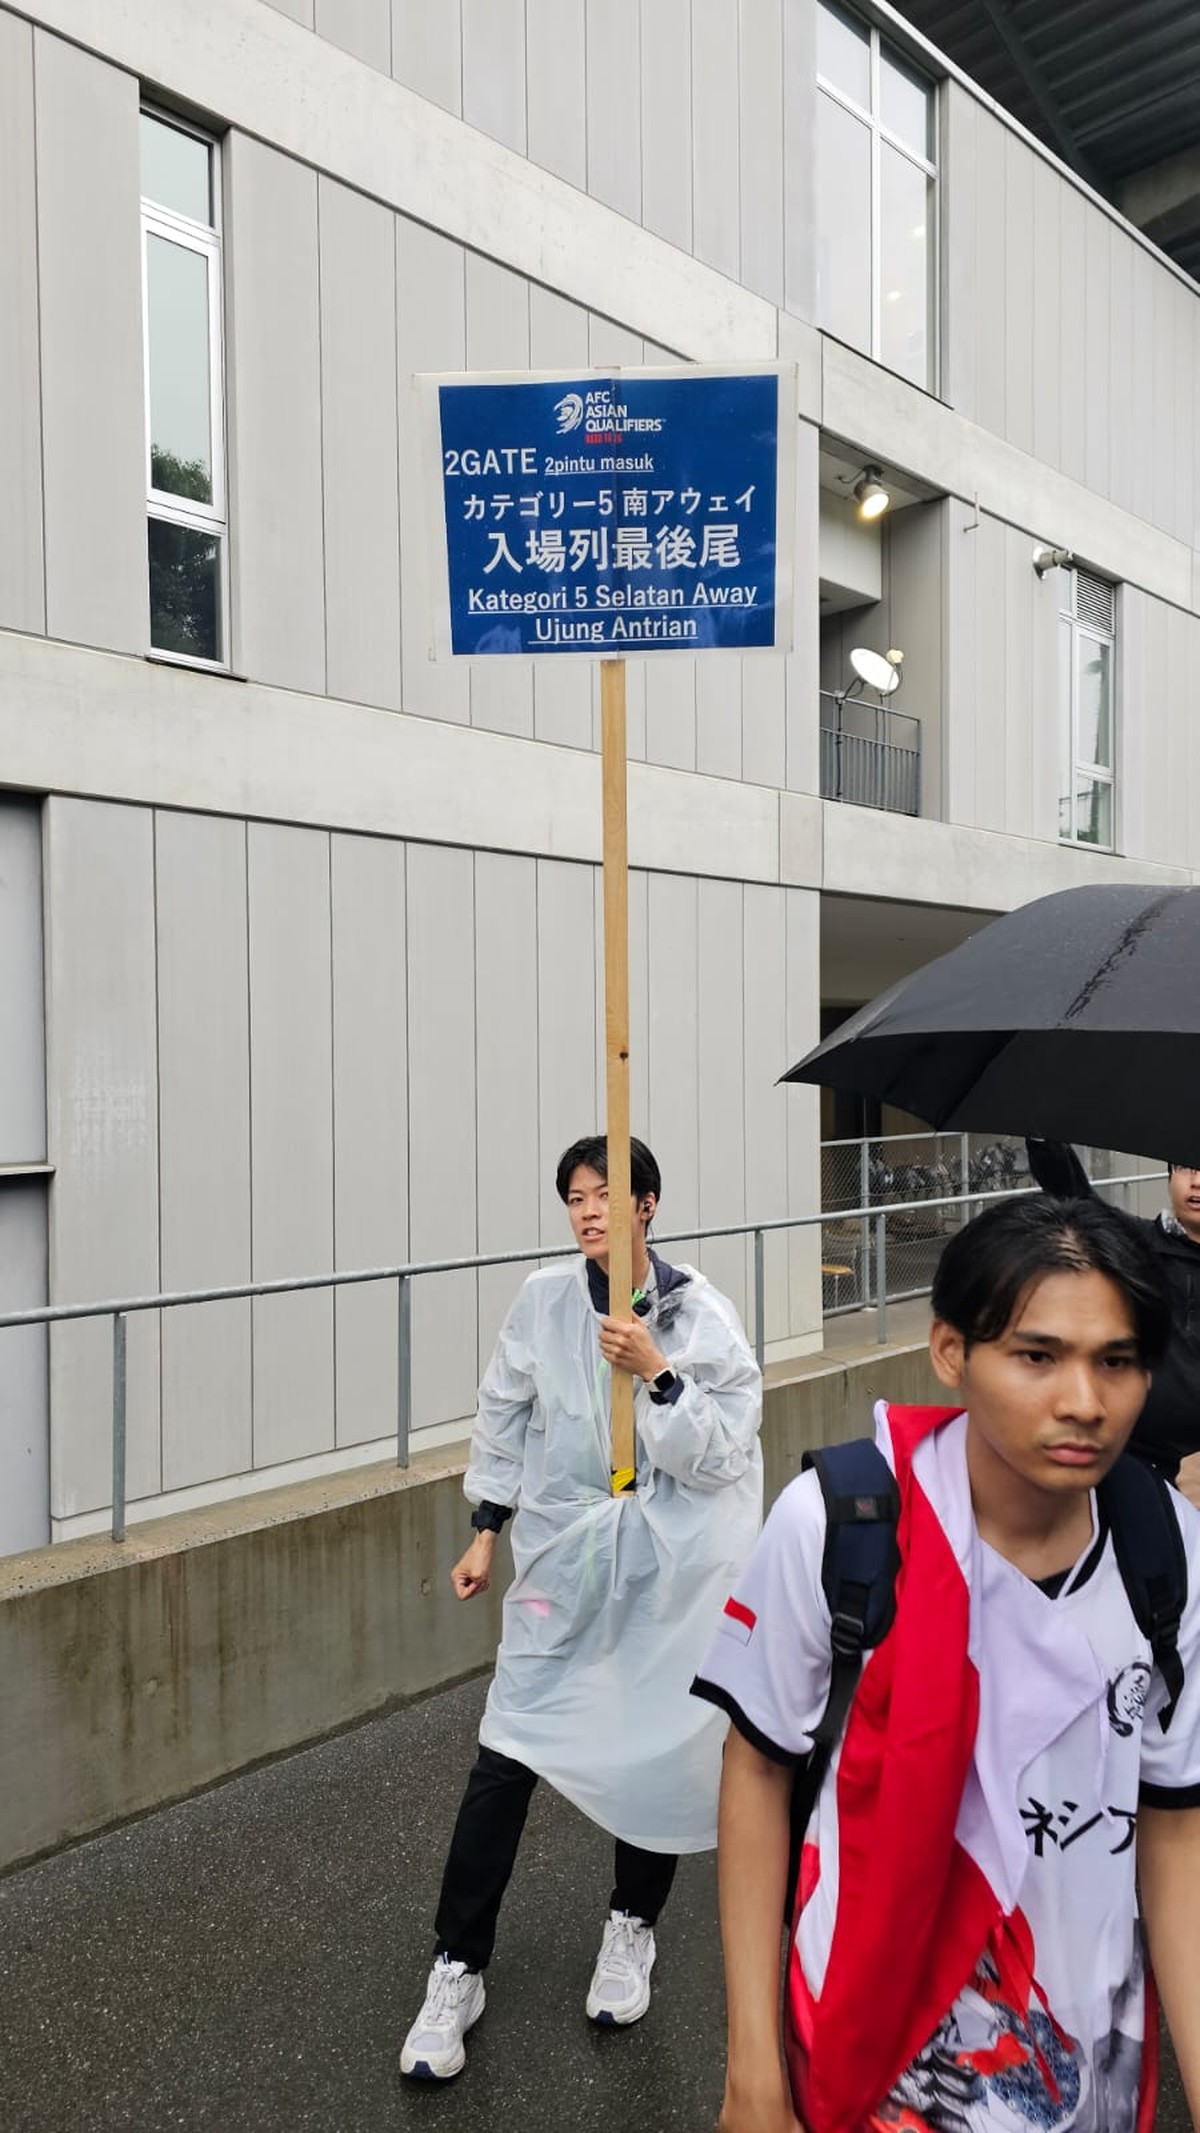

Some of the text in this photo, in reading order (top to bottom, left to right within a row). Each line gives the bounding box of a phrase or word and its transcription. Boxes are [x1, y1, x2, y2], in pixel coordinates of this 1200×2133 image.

[585, 391, 610, 404] AFC
[585, 404, 628, 418] ASIAN
[585, 418, 662, 432] QUALIFIERS
[445, 448, 654, 476] 2GATE 2pintu masuk
[463, 485, 756, 521] カテゴリー5 南アウェイ
[483, 525, 741, 574] 入場列最後尾
[468, 582, 757, 614] Kategori 5 Selatan Away
[536, 614, 697, 644] Ujung Antrian
